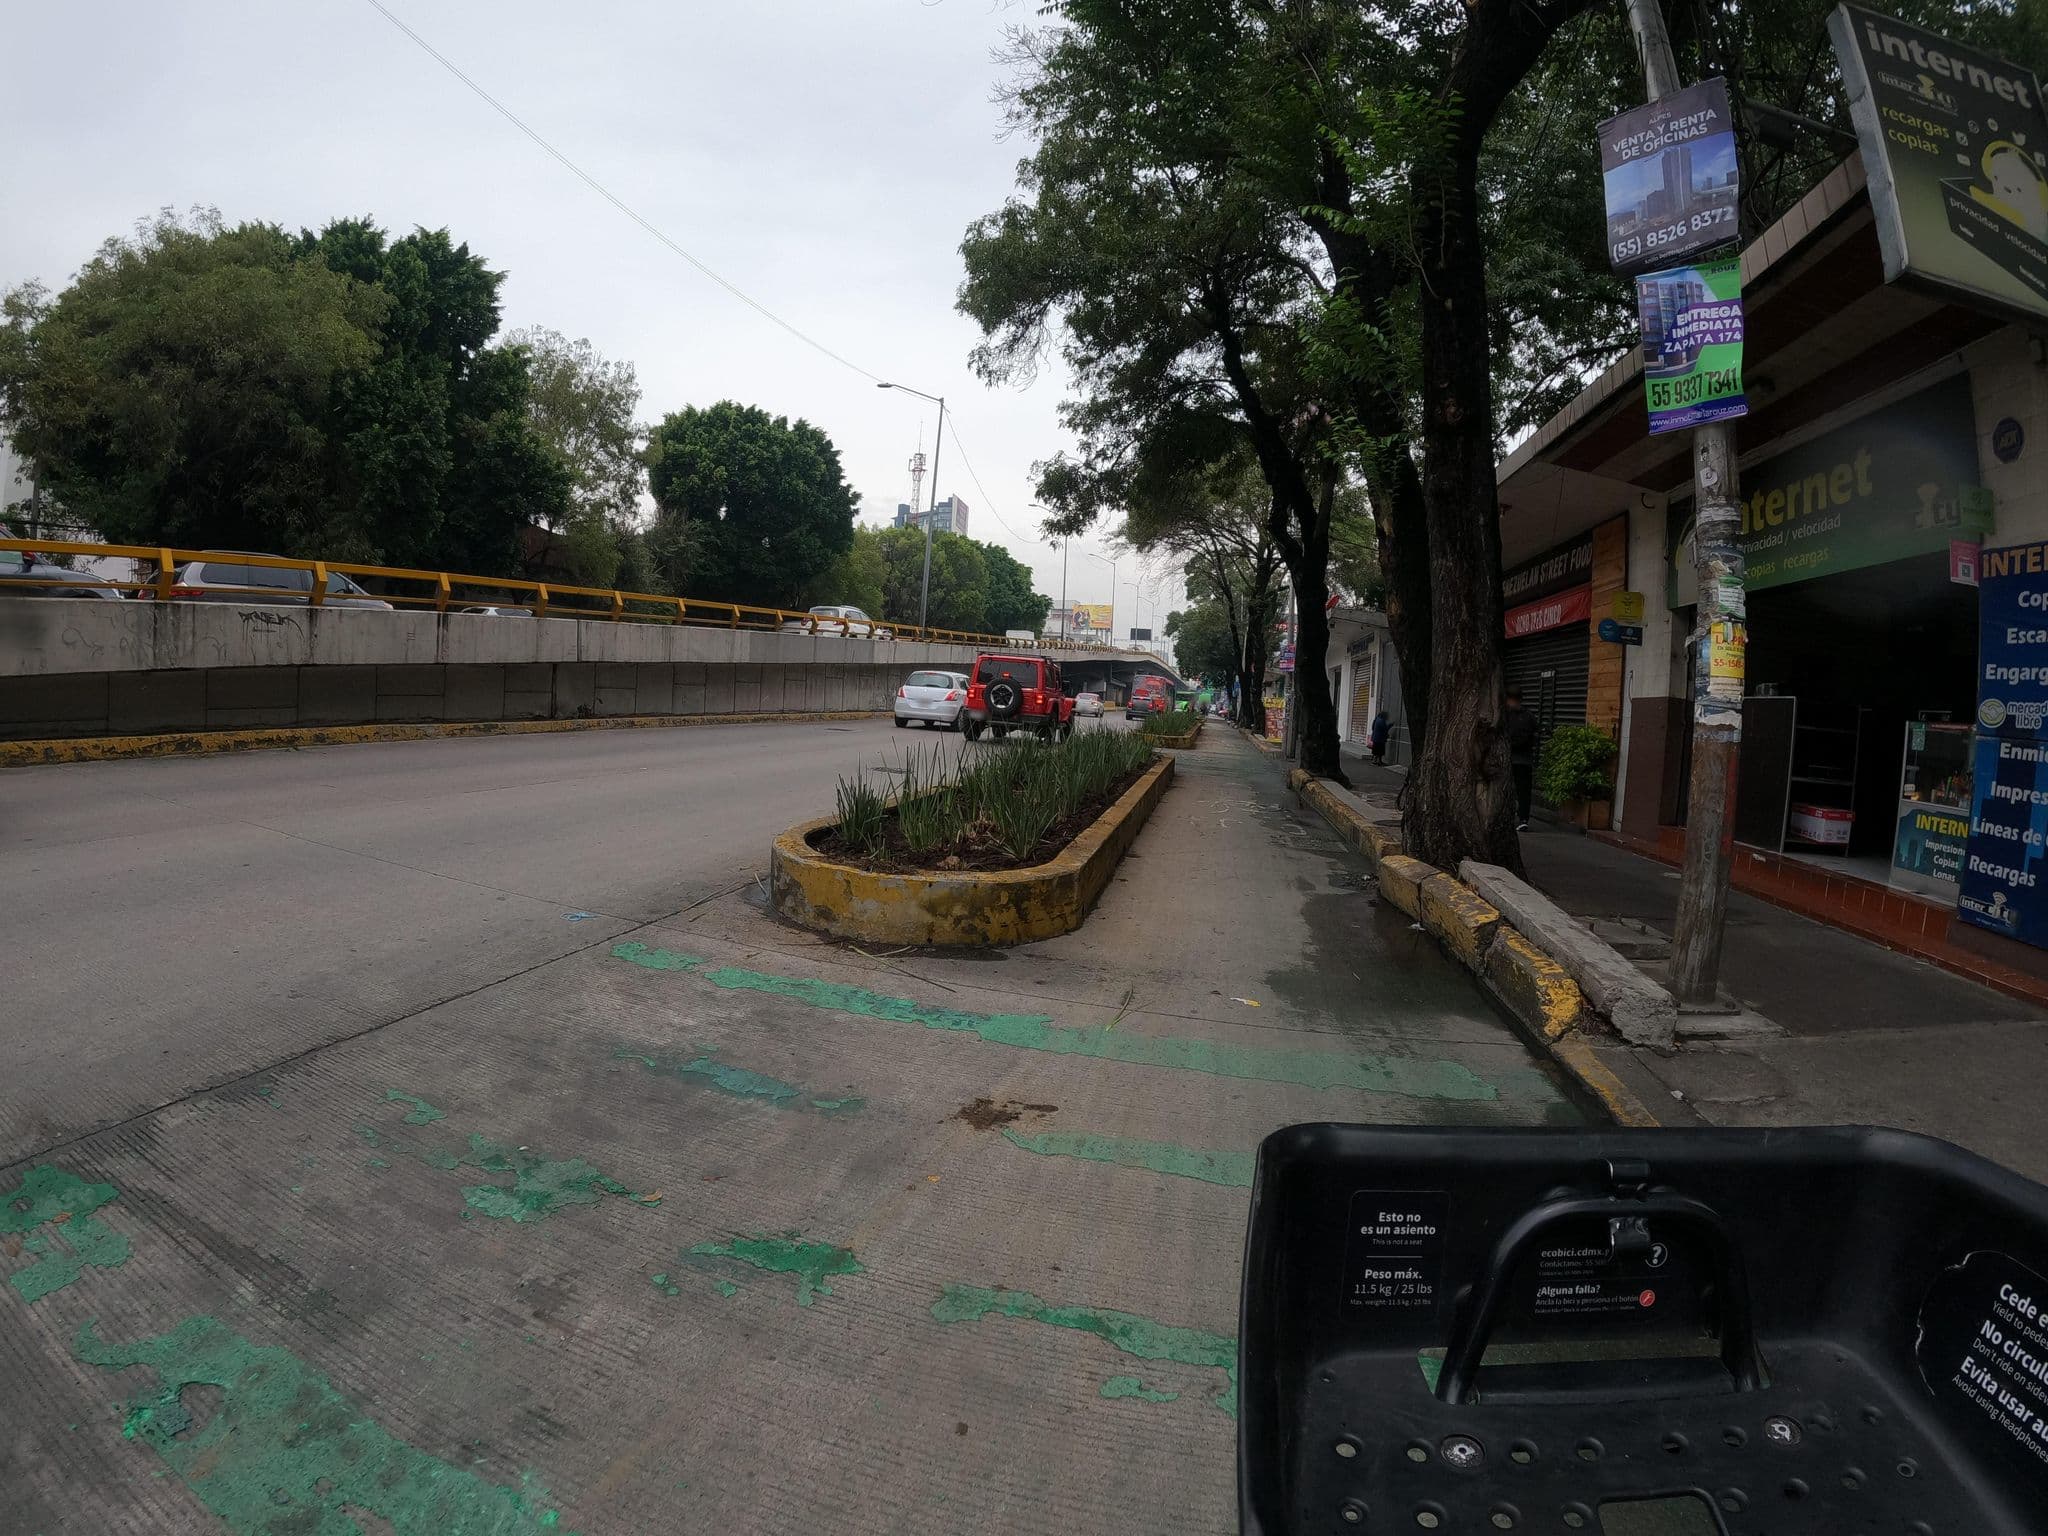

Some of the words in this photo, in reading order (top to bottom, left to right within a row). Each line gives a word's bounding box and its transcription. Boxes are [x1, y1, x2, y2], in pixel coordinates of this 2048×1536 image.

[1865, 21, 2032, 109] internet
[1612, 131, 1656, 153] VENTA
[1657, 123, 1666, 134] Y
[1670, 109, 1718, 131] RENTA
[1882, 106, 1950, 139] recargas
[1622, 146, 1640, 160] DE
[1643, 123, 1708, 153] OFICINAS
[1888, 129, 1940, 155] copias
[1613, 236, 1642, 263] (55)
[1646, 220, 1687, 247] 8526
[1691, 206, 1735, 231] 8372
[1676, 305, 1742, 326] ENTREGA
[1672, 318, 1742, 339] INMEDIATA
[1664, 334, 1714, 353] ZAPATA
[1718, 331, 1742, 343] 174
[1651, 382, 1671, 407] 55
[1674, 373, 1703, 404] 9337
[1704, 367, 1738, 396] 7341
[1791, 513, 1841, 540] velocidad
[1540, 552, 1568, 585] STREET
[1783, 547, 1829, 569] recargas
[2007, 627, 2048, 645] Esca
[1985, 663, 2048, 686] Engarg
[2016, 714, 2042, 728] libre
[1990, 781, 2048, 805] Impres
[1915, 814, 1969, 839] INTERN
[1972, 817, 2019, 841] Líneas
[2022, 828, 2043, 846] de
[1925, 839, 1966, 857] Impresion
[1933, 854, 1959, 868] Copias
[1969, 855, 2036, 887] Recargas
[1932, 868, 1956, 882] Lonas
[1378, 1211, 1404, 1222] Esto
[1406, 1213, 1421, 1222] no
[1360, 1226, 1374, 1235] es
[1376, 1226, 1391, 1235] un
[1393, 1224, 1436, 1235] asiento
[1364, 1268, 1392, 1279] Peso
[1394, 1267, 1422, 1279] máx.
[1354, 1284, 1377, 1294] 11.5
[1379, 1283, 1392, 1297] kg
[1401, 1283, 1415, 1294] 25
[1416, 1283, 1432, 1294] lbs
[1536, 1286, 1573, 1298] ¿Alguna
[1575, 1284, 1601, 1295] falla?
[1992, 1300, 2014, 1324] Yield
[2013, 1316, 2023, 1330] to
[2000, 1283, 2038, 1319] Cede
[2038, 1313, 2048, 1331] e
[1980, 1319, 2003, 1345] No
[1972, 1337, 1997, 1364] Don't
[1996, 1357, 2014, 1376] ride
[2014, 1371, 2027, 1386] on
[1960, 1355, 1998, 1396] Evita
[1998, 1389, 2034, 1423] usar
[1952, 1373, 1976, 1399] Avoid
[1976, 1392, 2000, 1421] using
[1998, 1410, 2048, 1465] headphones
